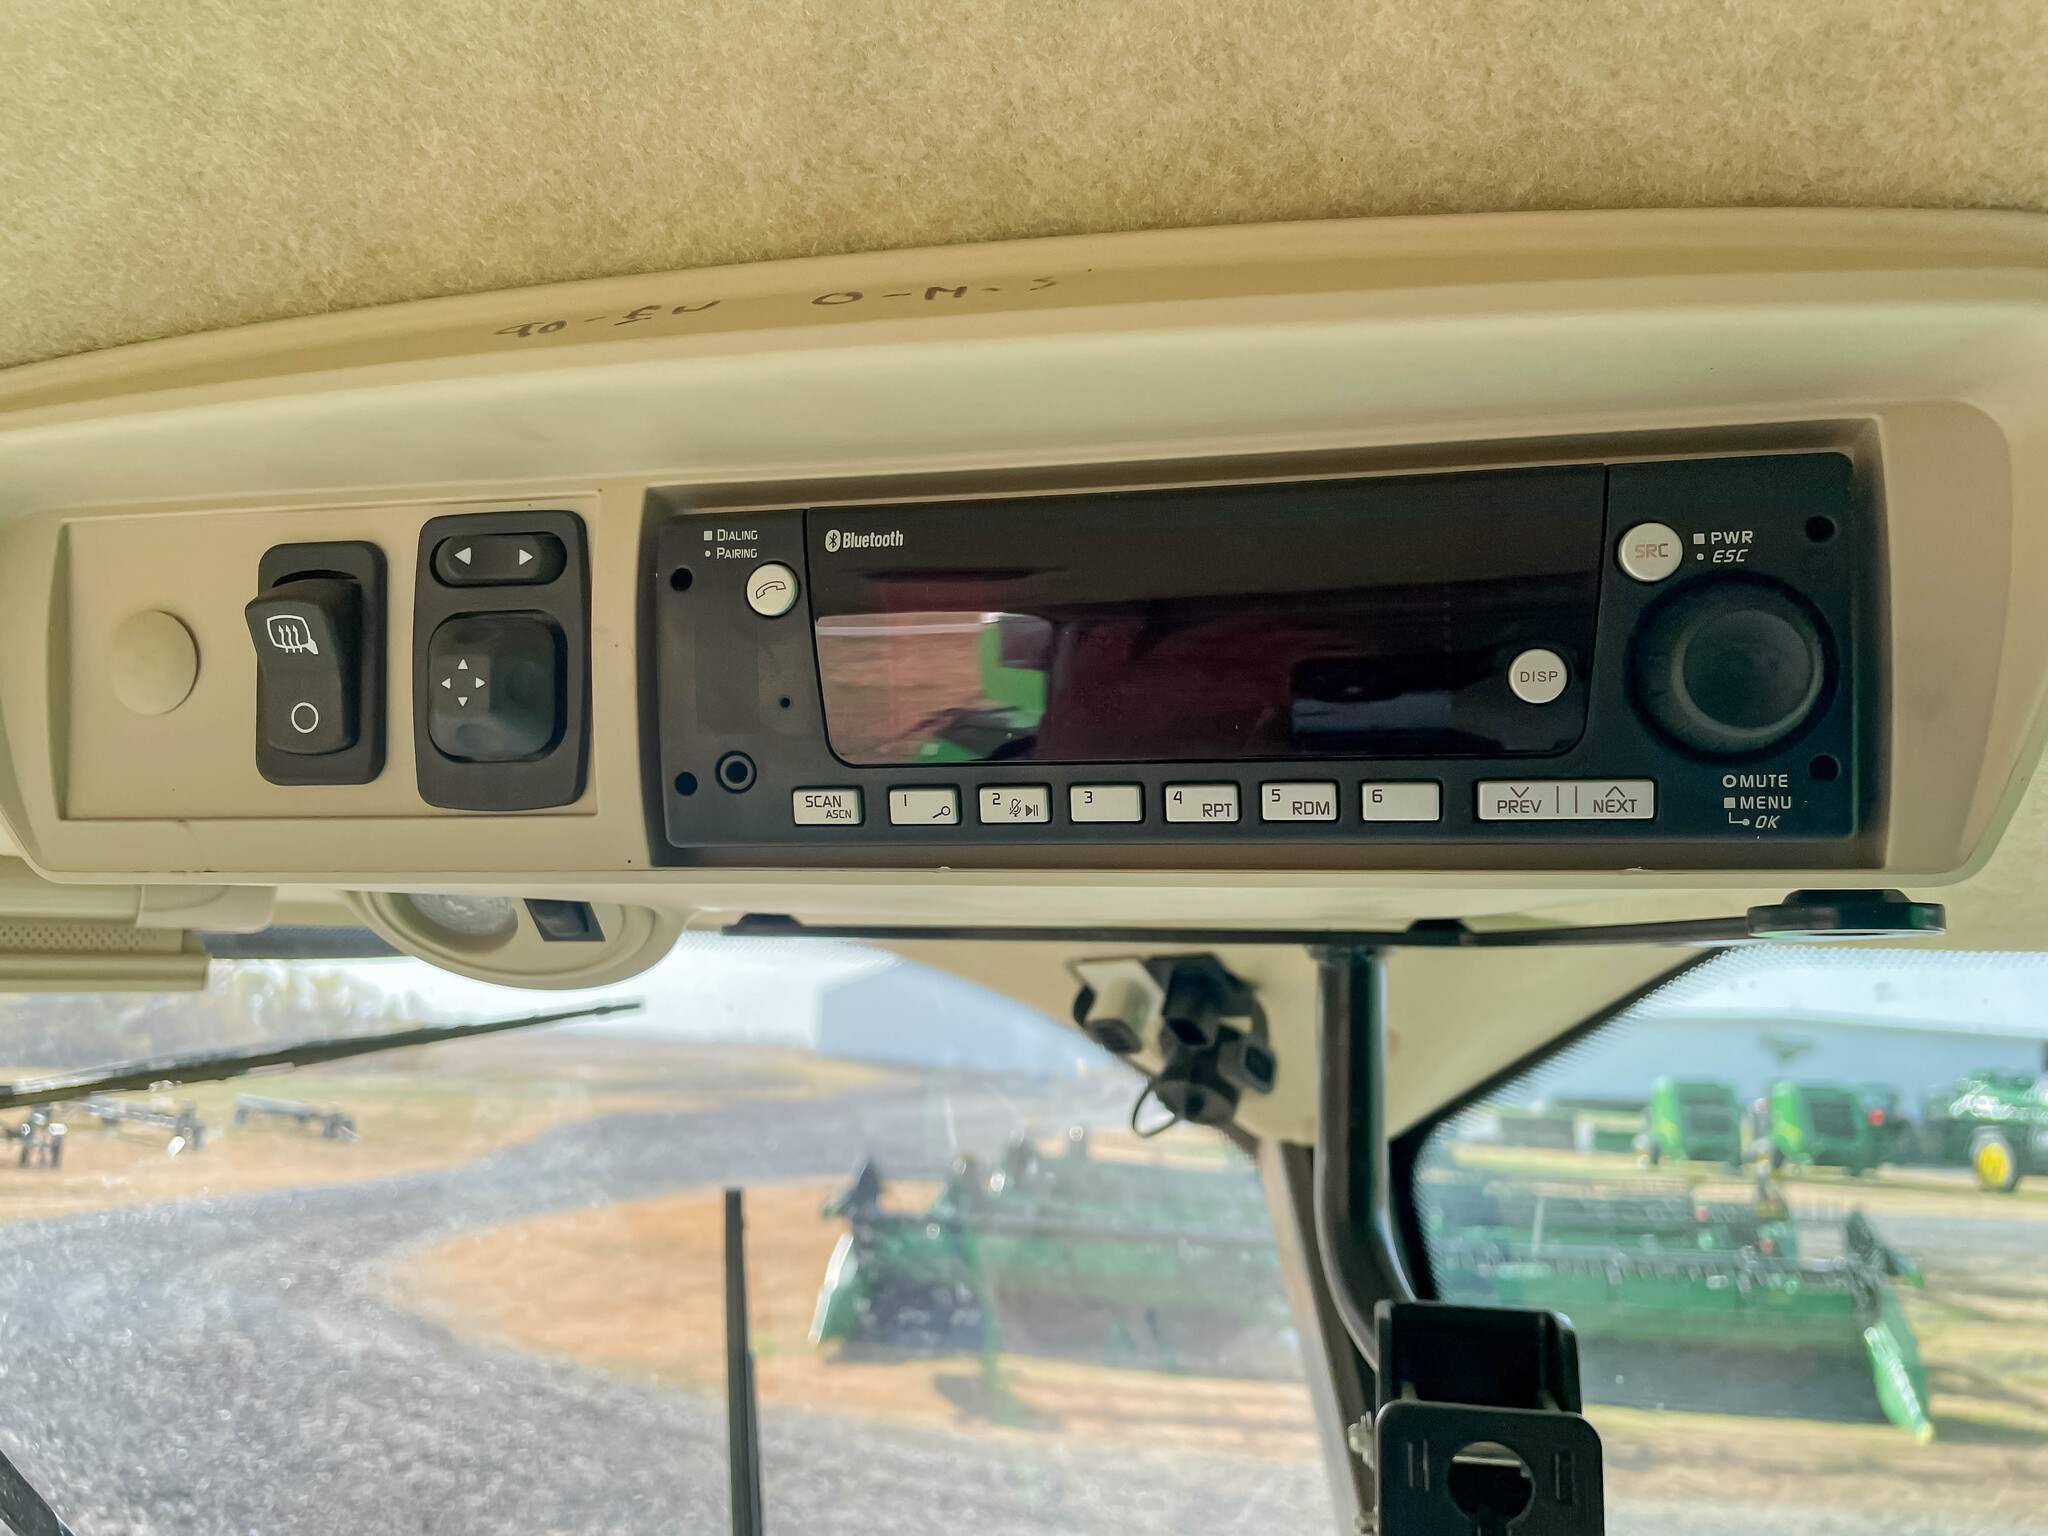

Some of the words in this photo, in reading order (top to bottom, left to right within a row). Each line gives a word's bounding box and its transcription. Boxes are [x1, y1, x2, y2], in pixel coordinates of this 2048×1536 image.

[842, 531, 904, 549] Bluetooth
[1710, 530, 1754, 545] PWR
[1634, 543, 1669, 559] SRC
[1712, 549, 1748, 563] ESC
[1519, 670, 1558, 683] DISP
[1739, 774, 1788, 788] MUTE
[805, 795, 842, 808] SCAN
[992, 793, 1001, 806] 2
[1084, 791, 1093, 804] 3
[1173, 791, 1183, 804] 4
[1271, 789, 1281, 802] 5
[1372, 789, 1383, 803] 6
[1739, 796, 1792, 809] MENU
[1202, 803, 1232, 817] RPT
[1292, 801, 1330, 816] RDM
[1497, 800, 1542, 814] PREV
[1593, 799, 1637, 813] NEXT
[826, 809, 852, 819] ASCN
[1755, 815, 1780, 829] OK
